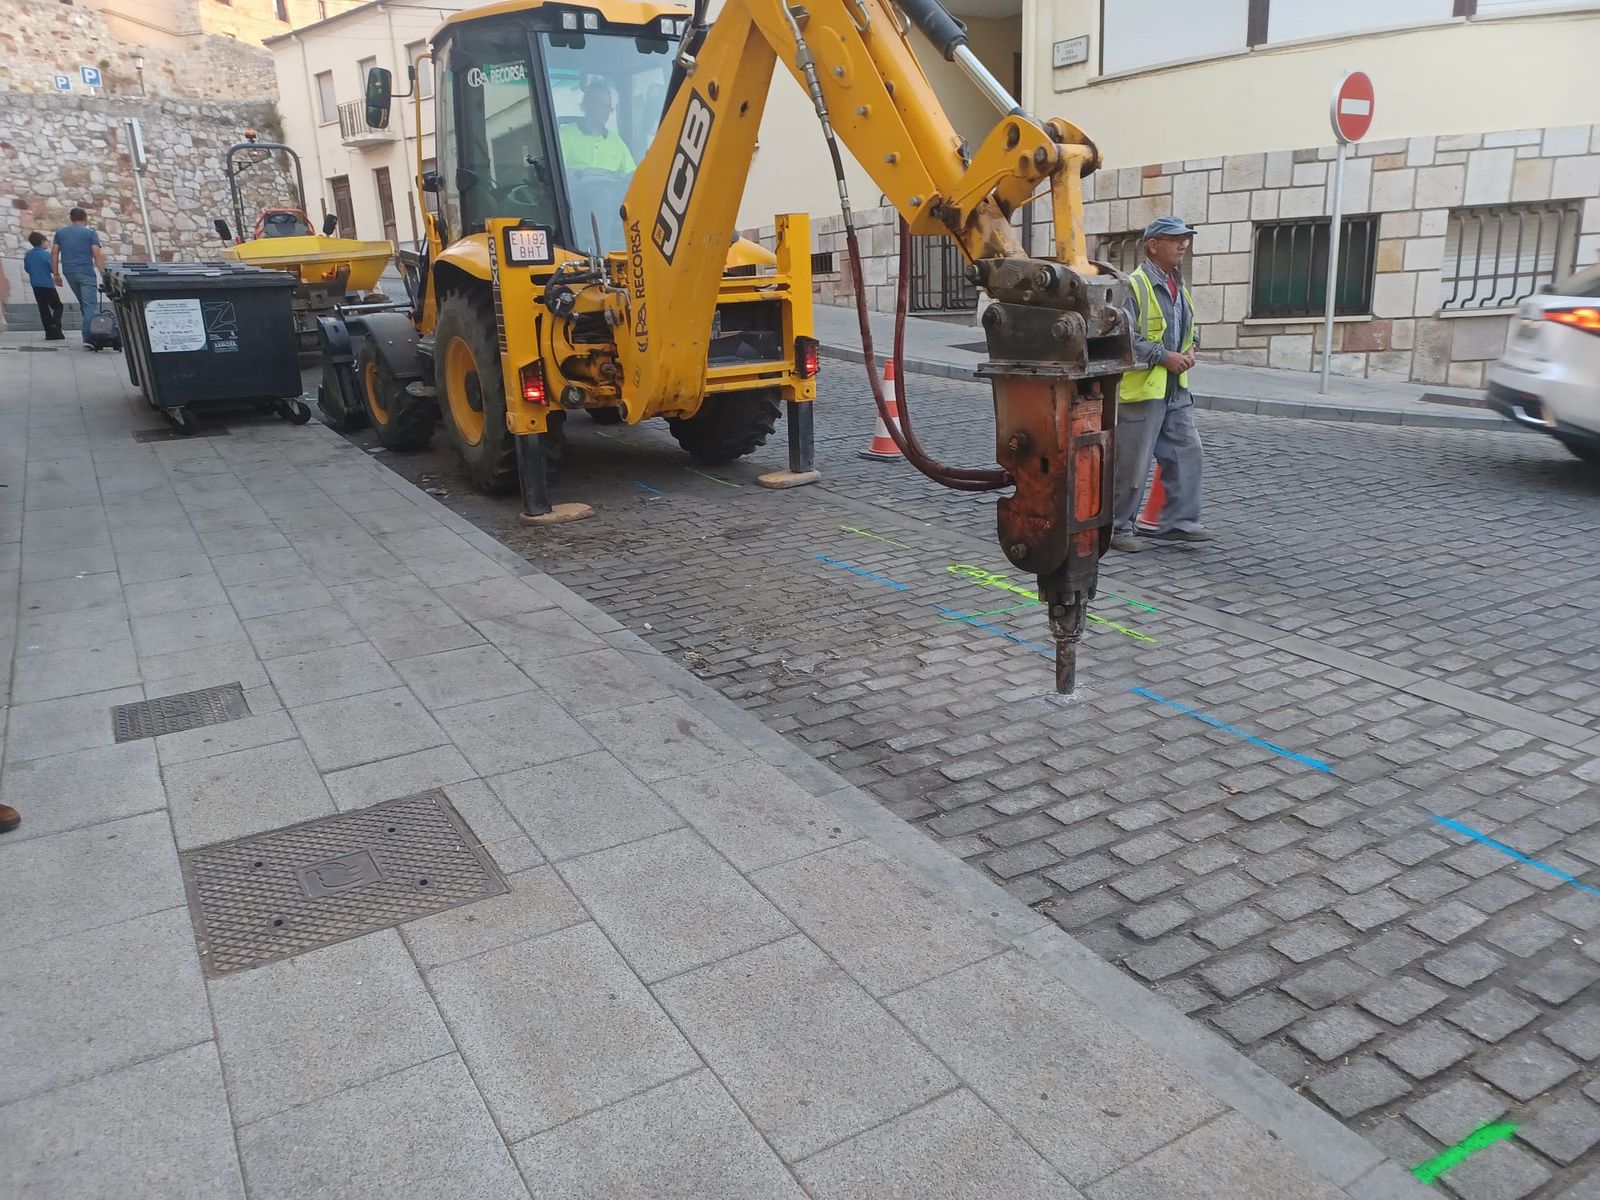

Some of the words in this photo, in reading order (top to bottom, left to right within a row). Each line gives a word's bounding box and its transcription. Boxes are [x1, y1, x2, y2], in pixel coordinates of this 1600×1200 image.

[84, 69, 97, 83] P
[490, 65, 525, 83] RECORSA
[57, 77, 67, 88] P
[661, 98, 711, 257] JCB
[511, 232, 545, 246] E1192
[520, 245, 541, 258] BHT
[631, 220, 646, 299] RECORSA
[488, 238, 500, 286] 3CX
